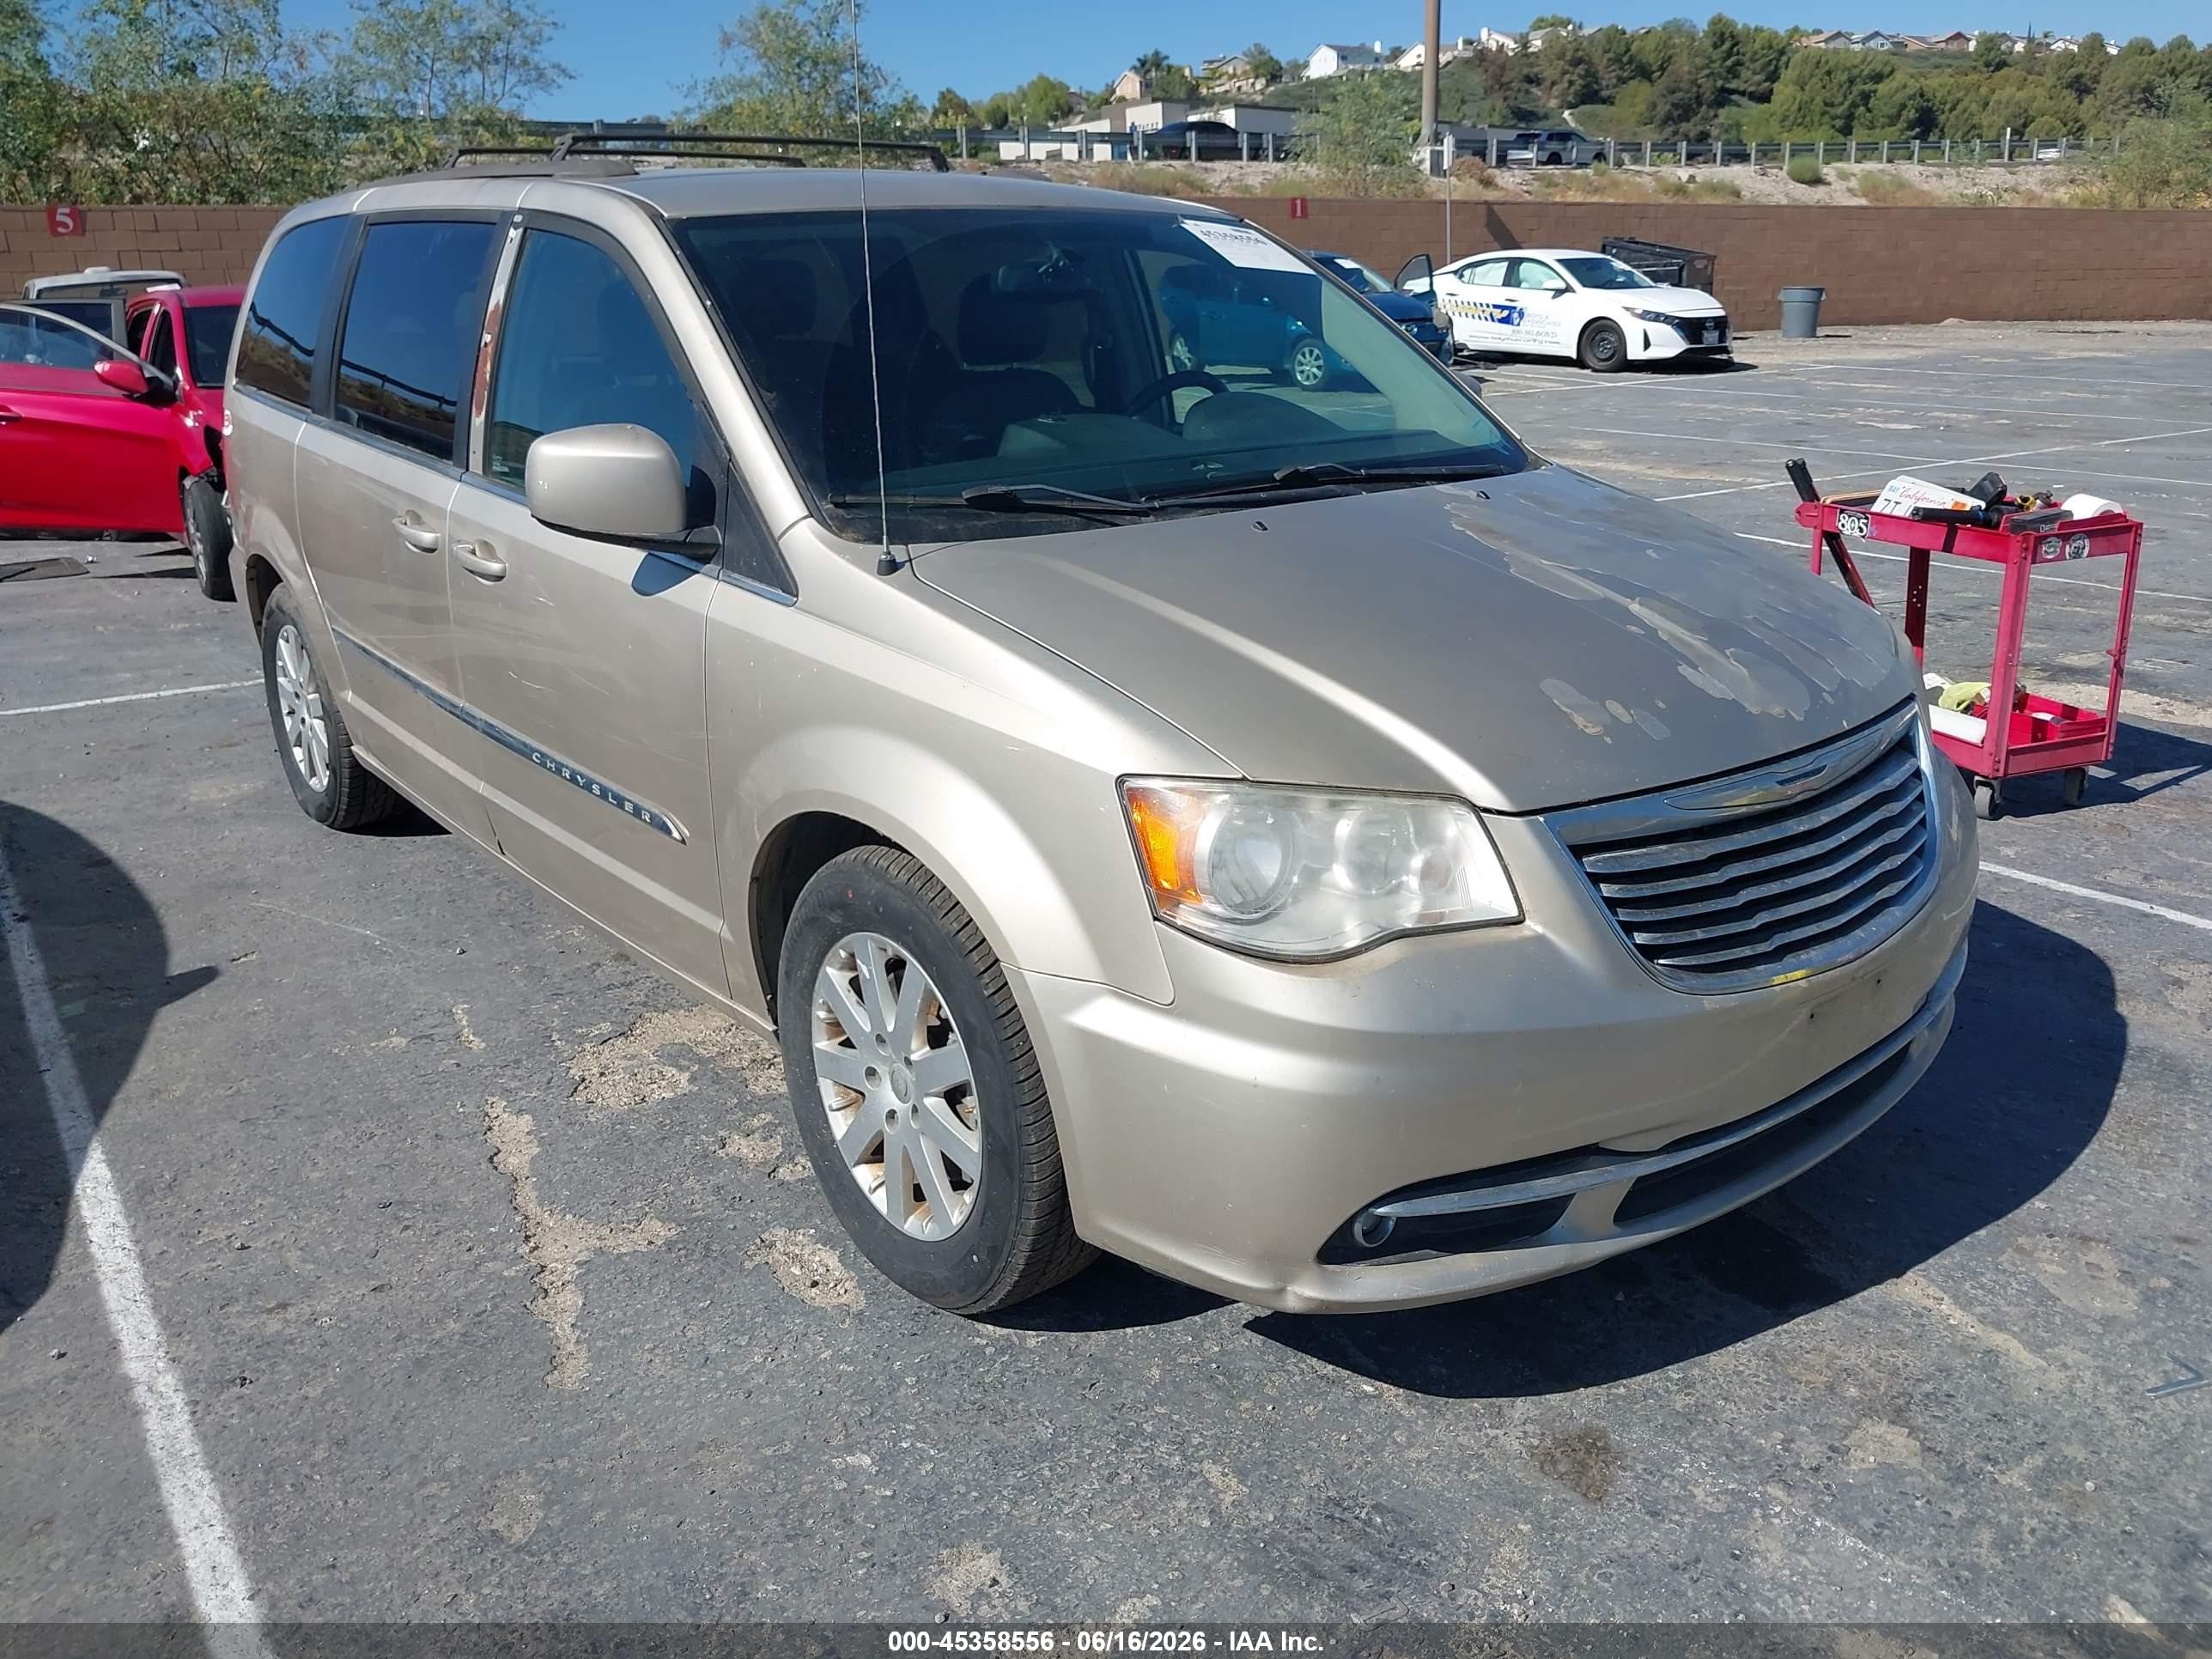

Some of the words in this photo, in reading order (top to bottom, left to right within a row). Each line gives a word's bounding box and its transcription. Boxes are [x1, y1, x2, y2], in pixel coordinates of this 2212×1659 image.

[1295, 198, 1302, 216] 1
[55, 207, 74, 233] 5
[1838, 514, 1869, 536] 805
[532, 752, 652, 823] CHRYSLER
